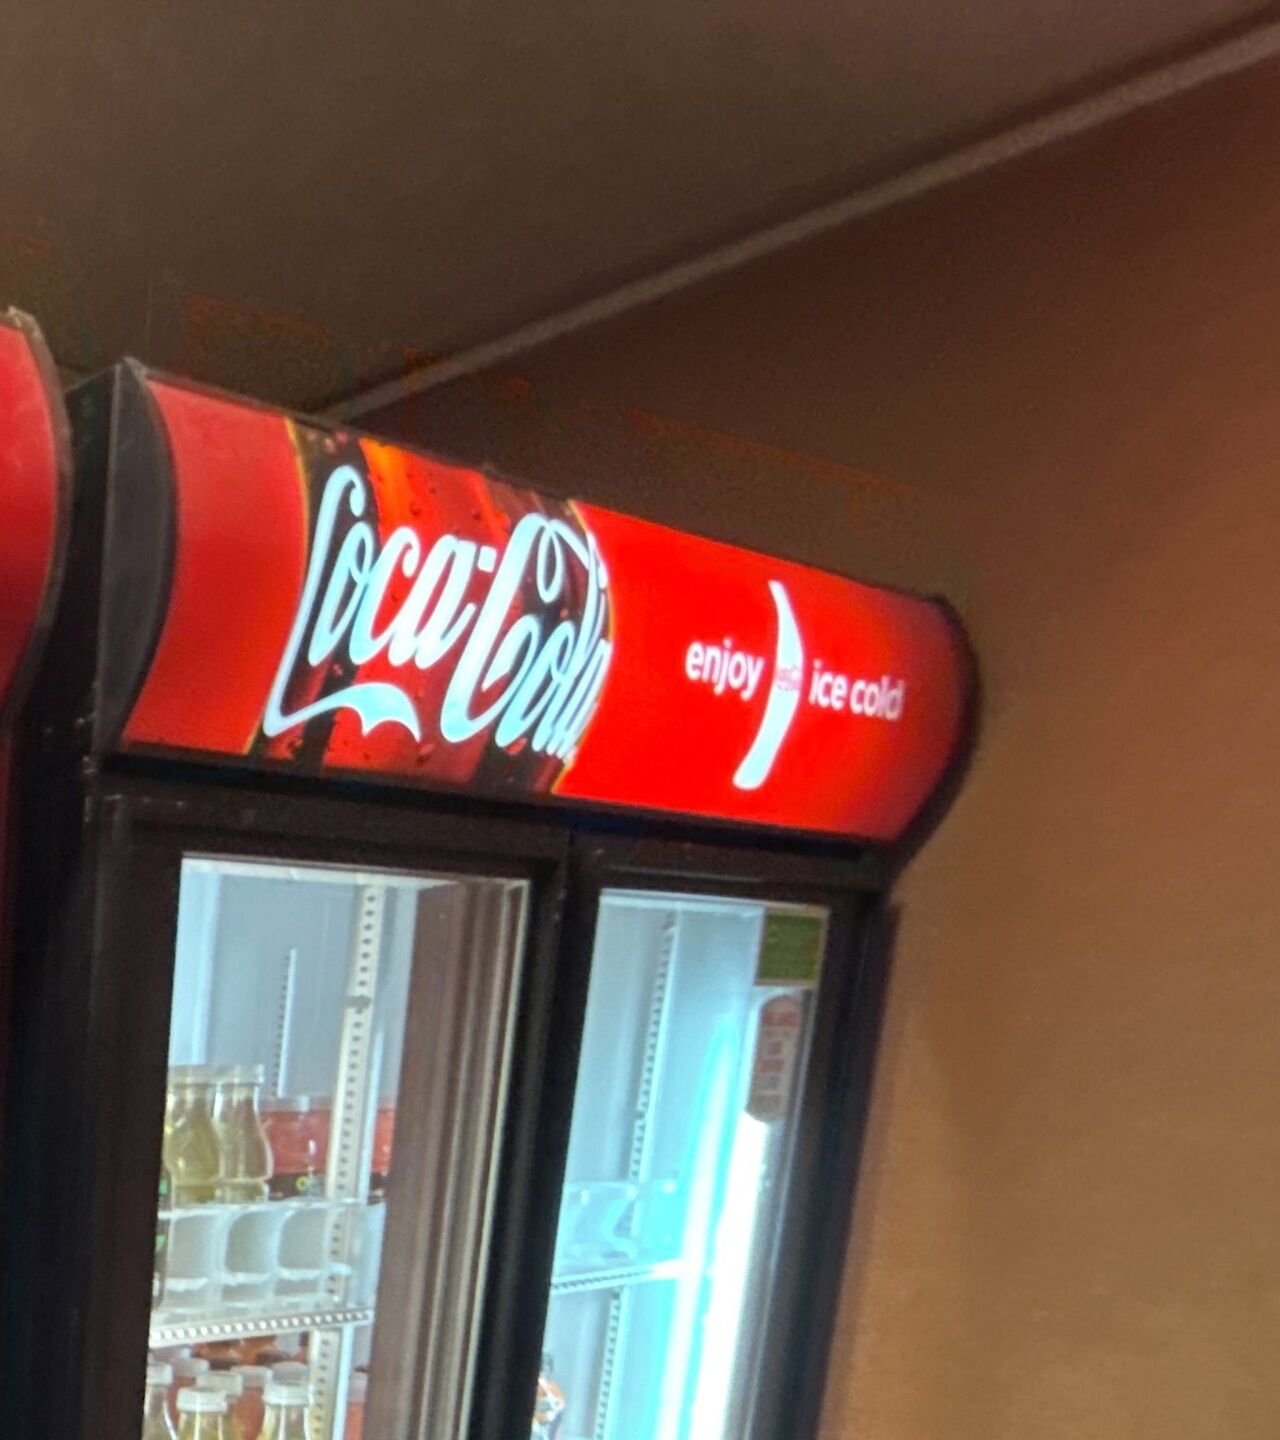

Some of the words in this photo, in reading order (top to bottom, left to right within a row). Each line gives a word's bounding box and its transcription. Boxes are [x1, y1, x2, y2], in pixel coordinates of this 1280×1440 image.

[262, 464, 612, 766] Coca-Cola
[685, 636, 764, 702] enjoy
[808, 658, 848, 712] ice
[850, 674, 906, 721] cold
